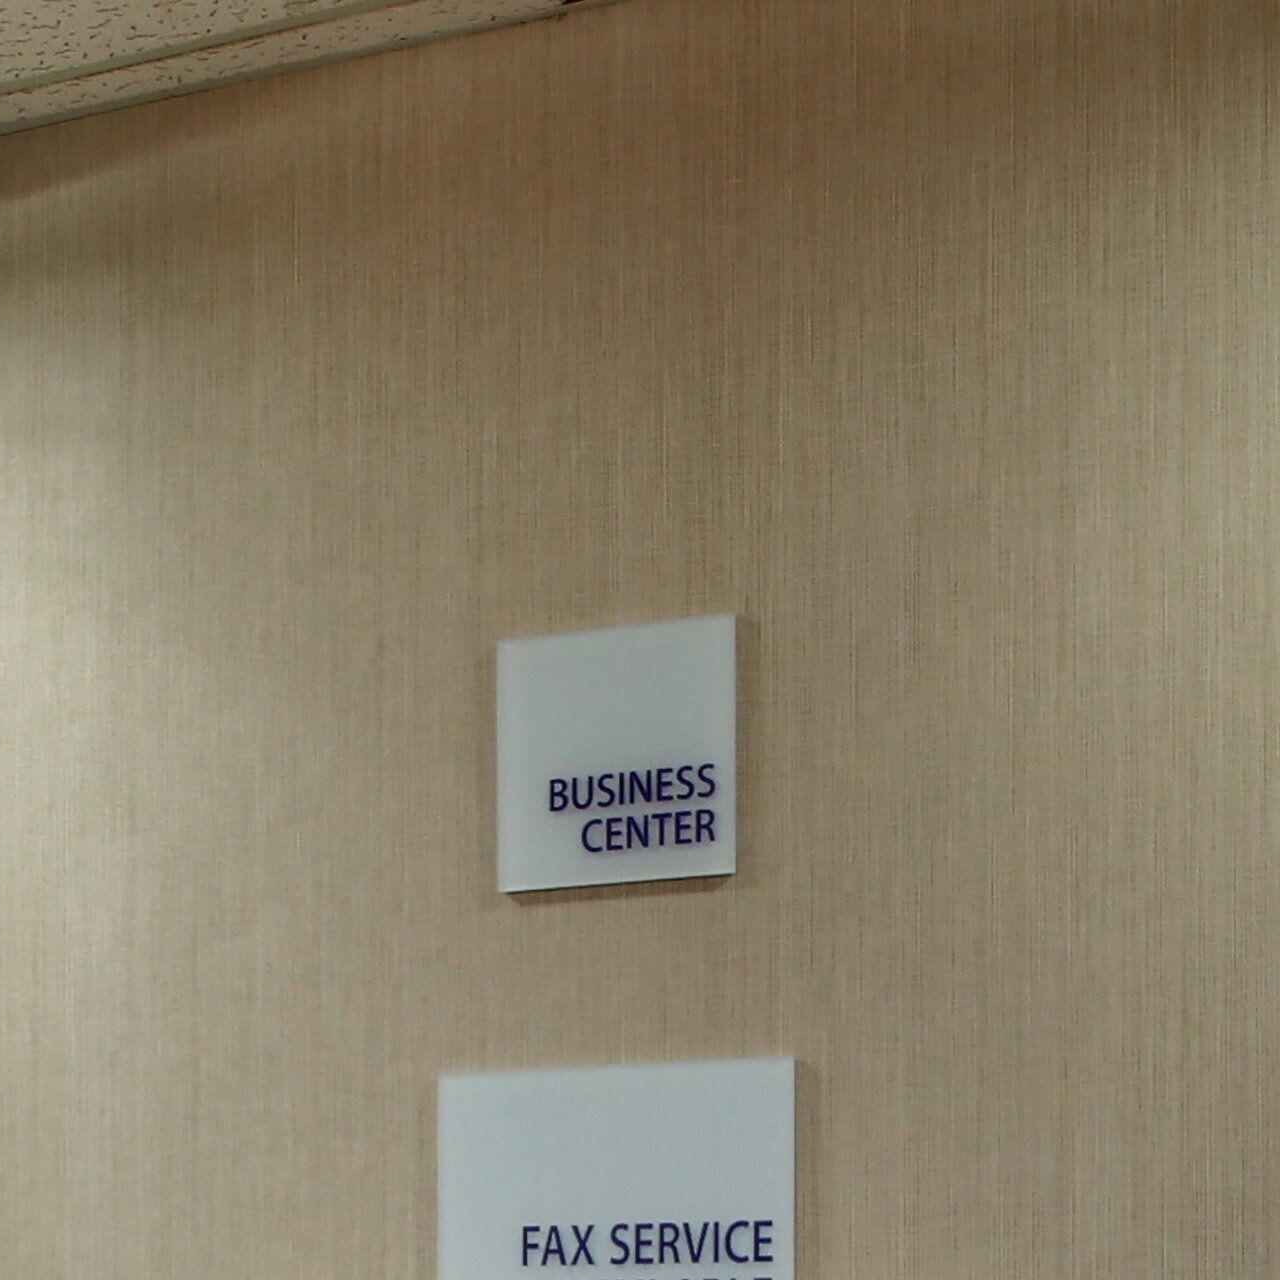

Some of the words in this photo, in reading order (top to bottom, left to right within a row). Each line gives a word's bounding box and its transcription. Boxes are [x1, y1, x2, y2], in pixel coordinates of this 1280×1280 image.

[550, 764, 716, 812] BUSINESS
[581, 809, 716, 853] CENTER
[522, 1224, 595, 1267] FAX
[609, 1220, 774, 1266] SERVICE
